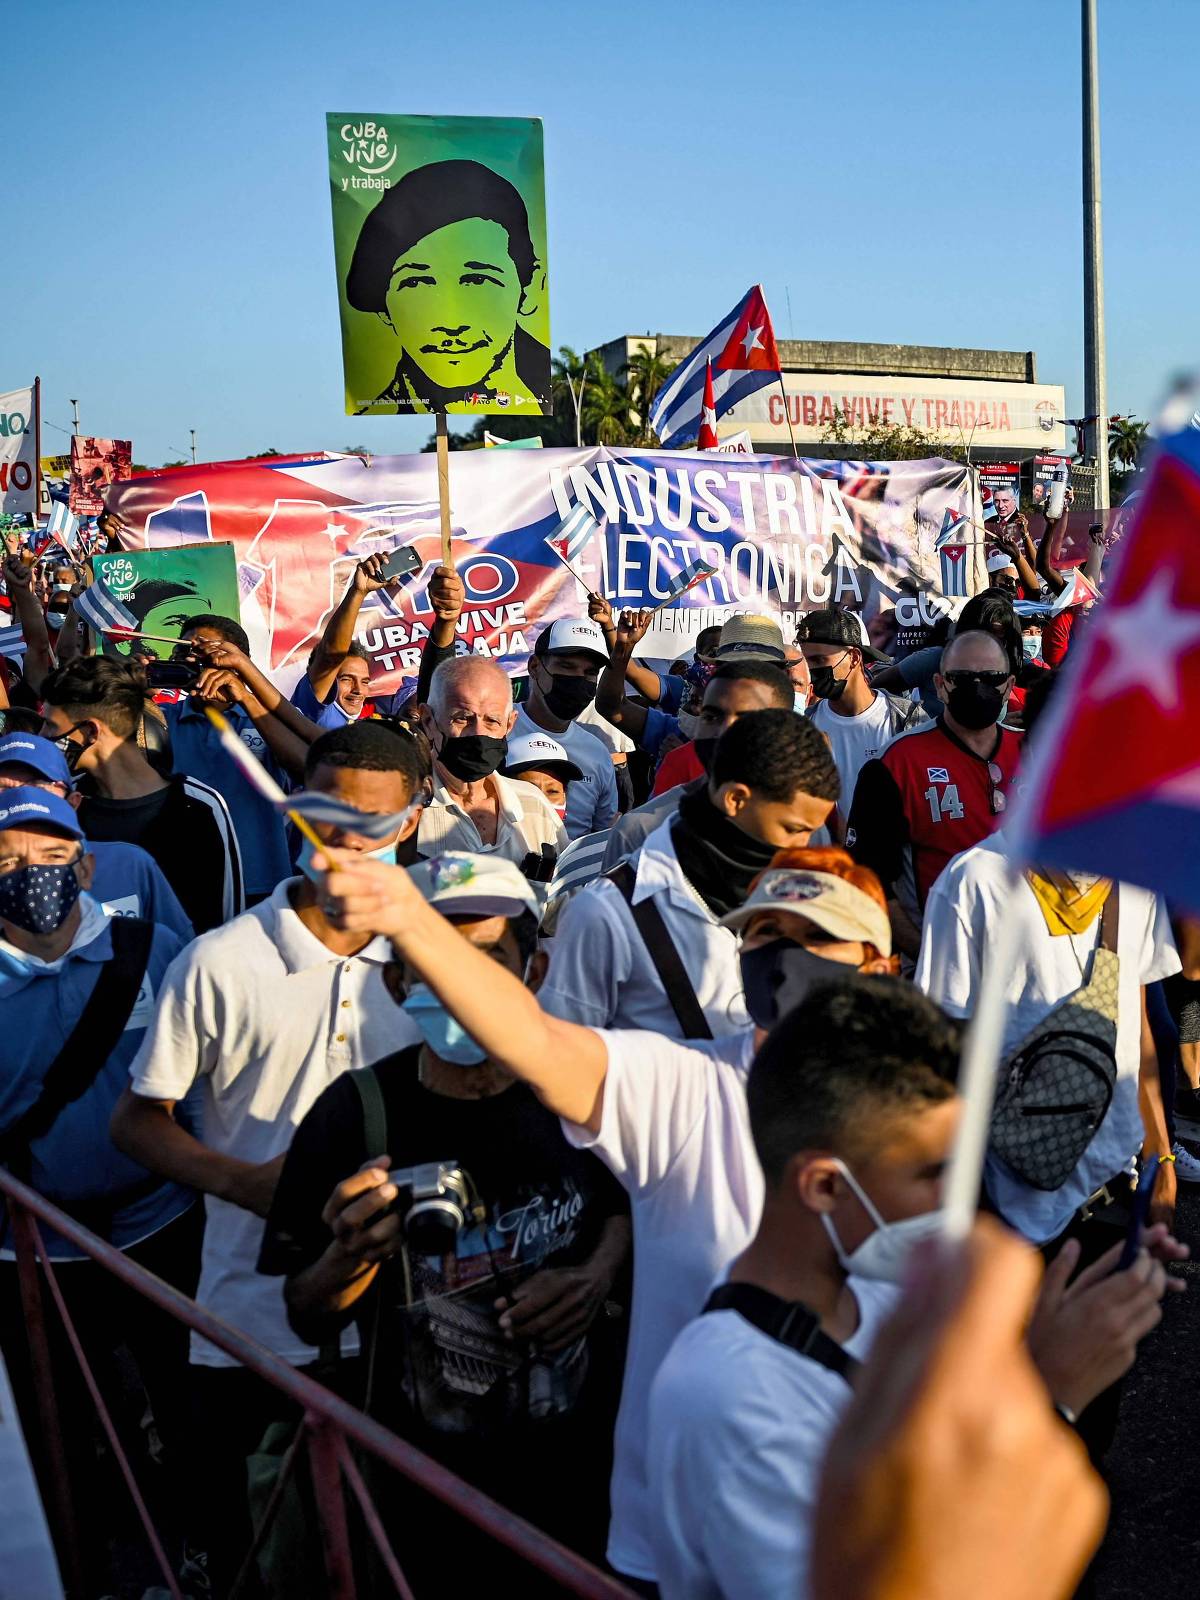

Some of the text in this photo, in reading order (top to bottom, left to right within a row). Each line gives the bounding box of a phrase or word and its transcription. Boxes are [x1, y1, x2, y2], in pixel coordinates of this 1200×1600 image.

[341, 122, 389, 143] CUBA
[341, 174, 391, 192] y trabaja
[768, 394, 1011, 431] CUBA VIVE Y TRABAJA
[549, 462, 858, 542] INDUSTRIA
[101, 558, 134, 573] CUBA
[115, 591, 136, 602] abaja
[352, 602, 527, 655] UBA VIVE
[897, 631, 927, 639] EMPRES
[374, 630, 531, 671] TRBAJA
[924, 784, 964, 823] 14
[496, 1193, 583, 1259] Torino
